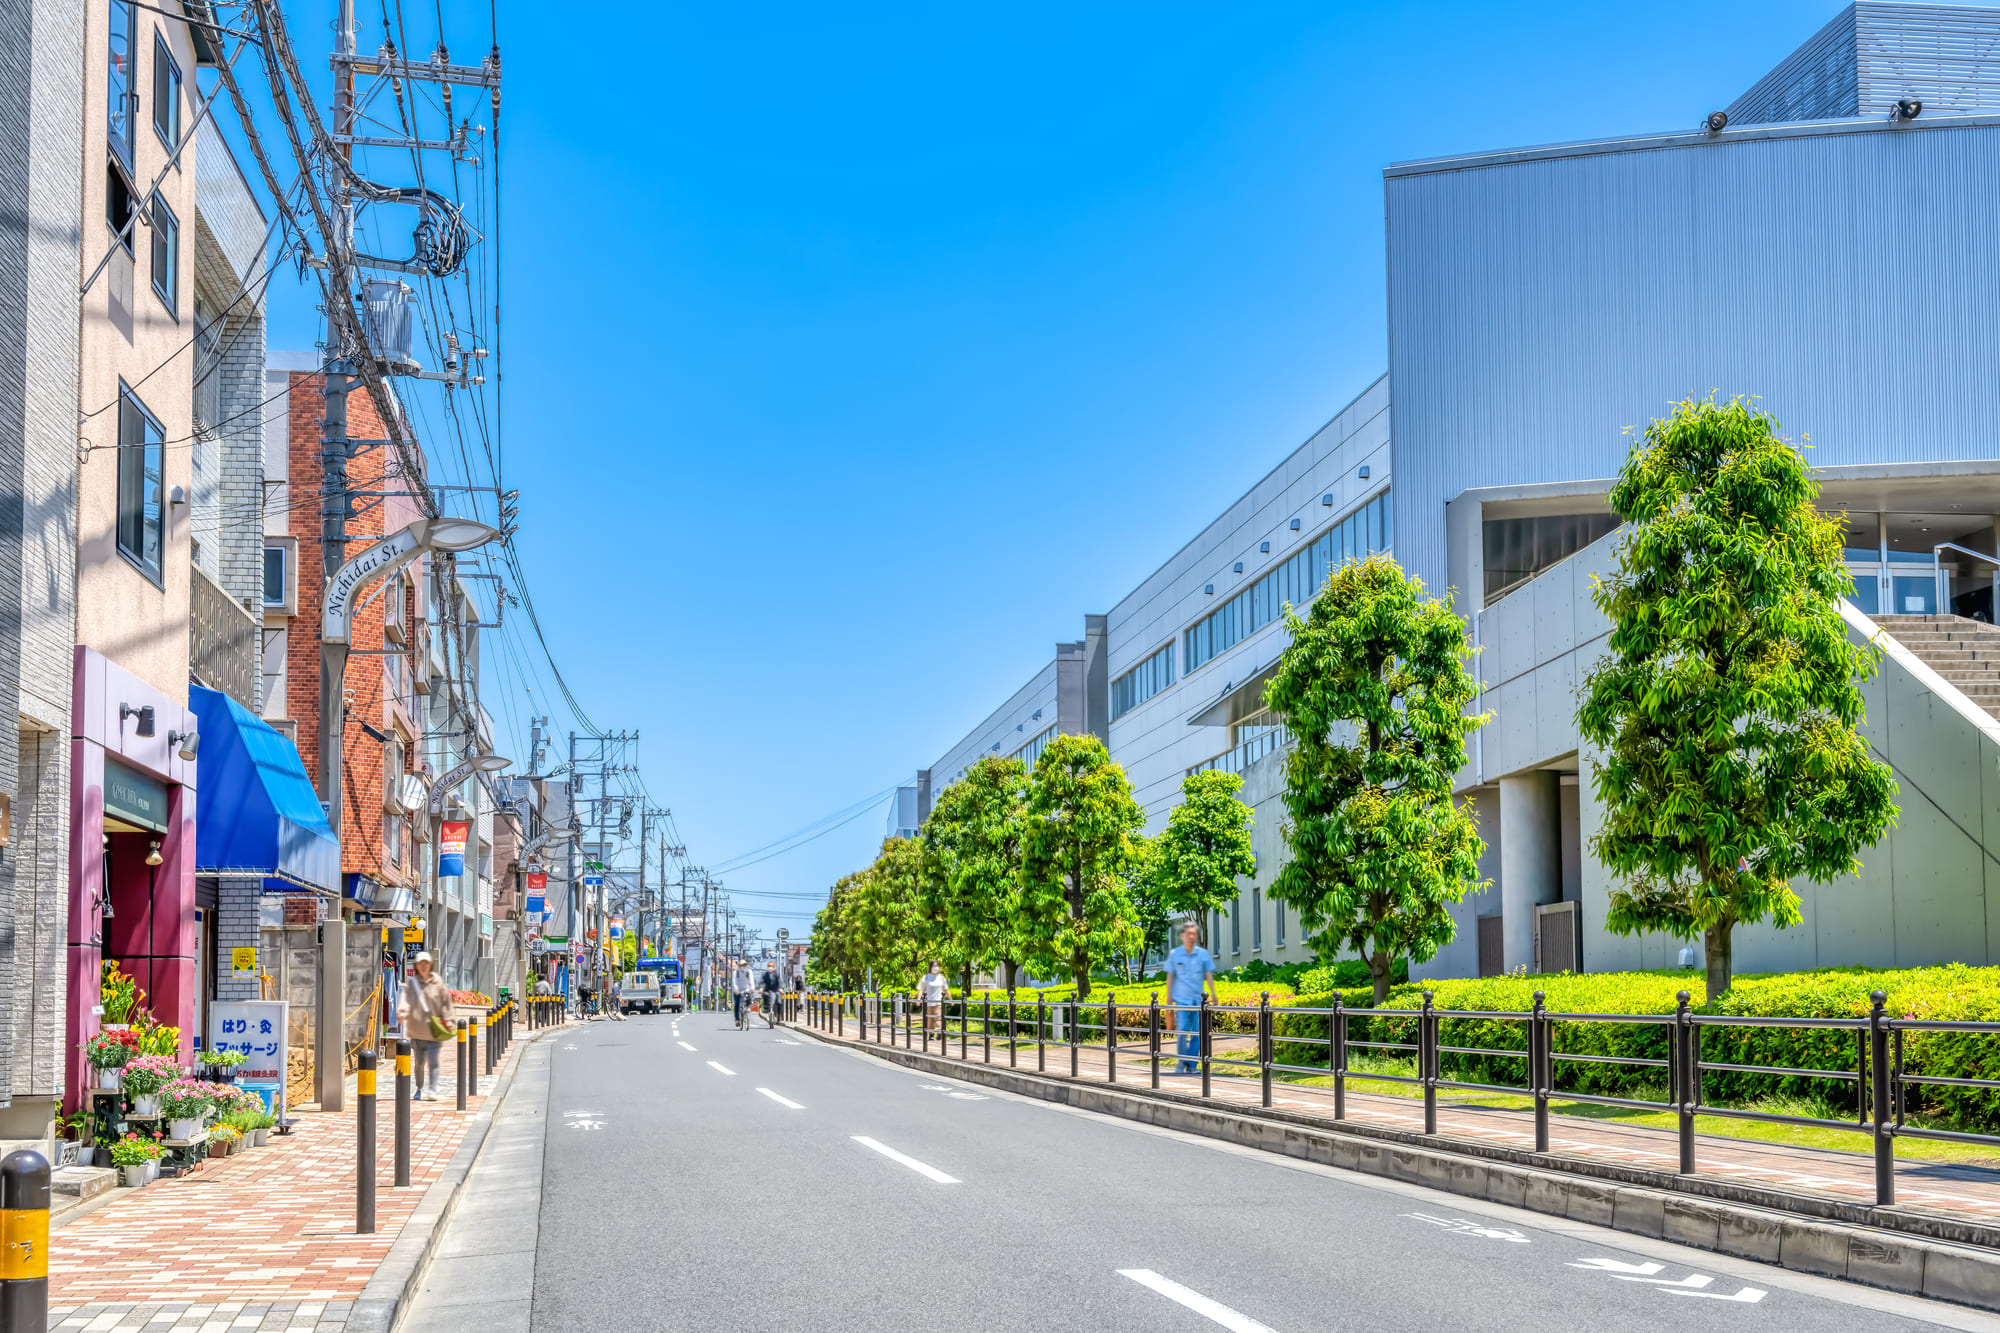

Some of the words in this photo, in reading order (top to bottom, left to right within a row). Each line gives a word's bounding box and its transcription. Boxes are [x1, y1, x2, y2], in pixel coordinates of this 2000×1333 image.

[328, 552, 379, 618] Nichidai
[382, 544, 405, 562] St.
[432, 775, 456, 804] Nichidai
[223, 1019, 272, 1034] はり・灸
[216, 1042, 278, 1056] マッサージ
